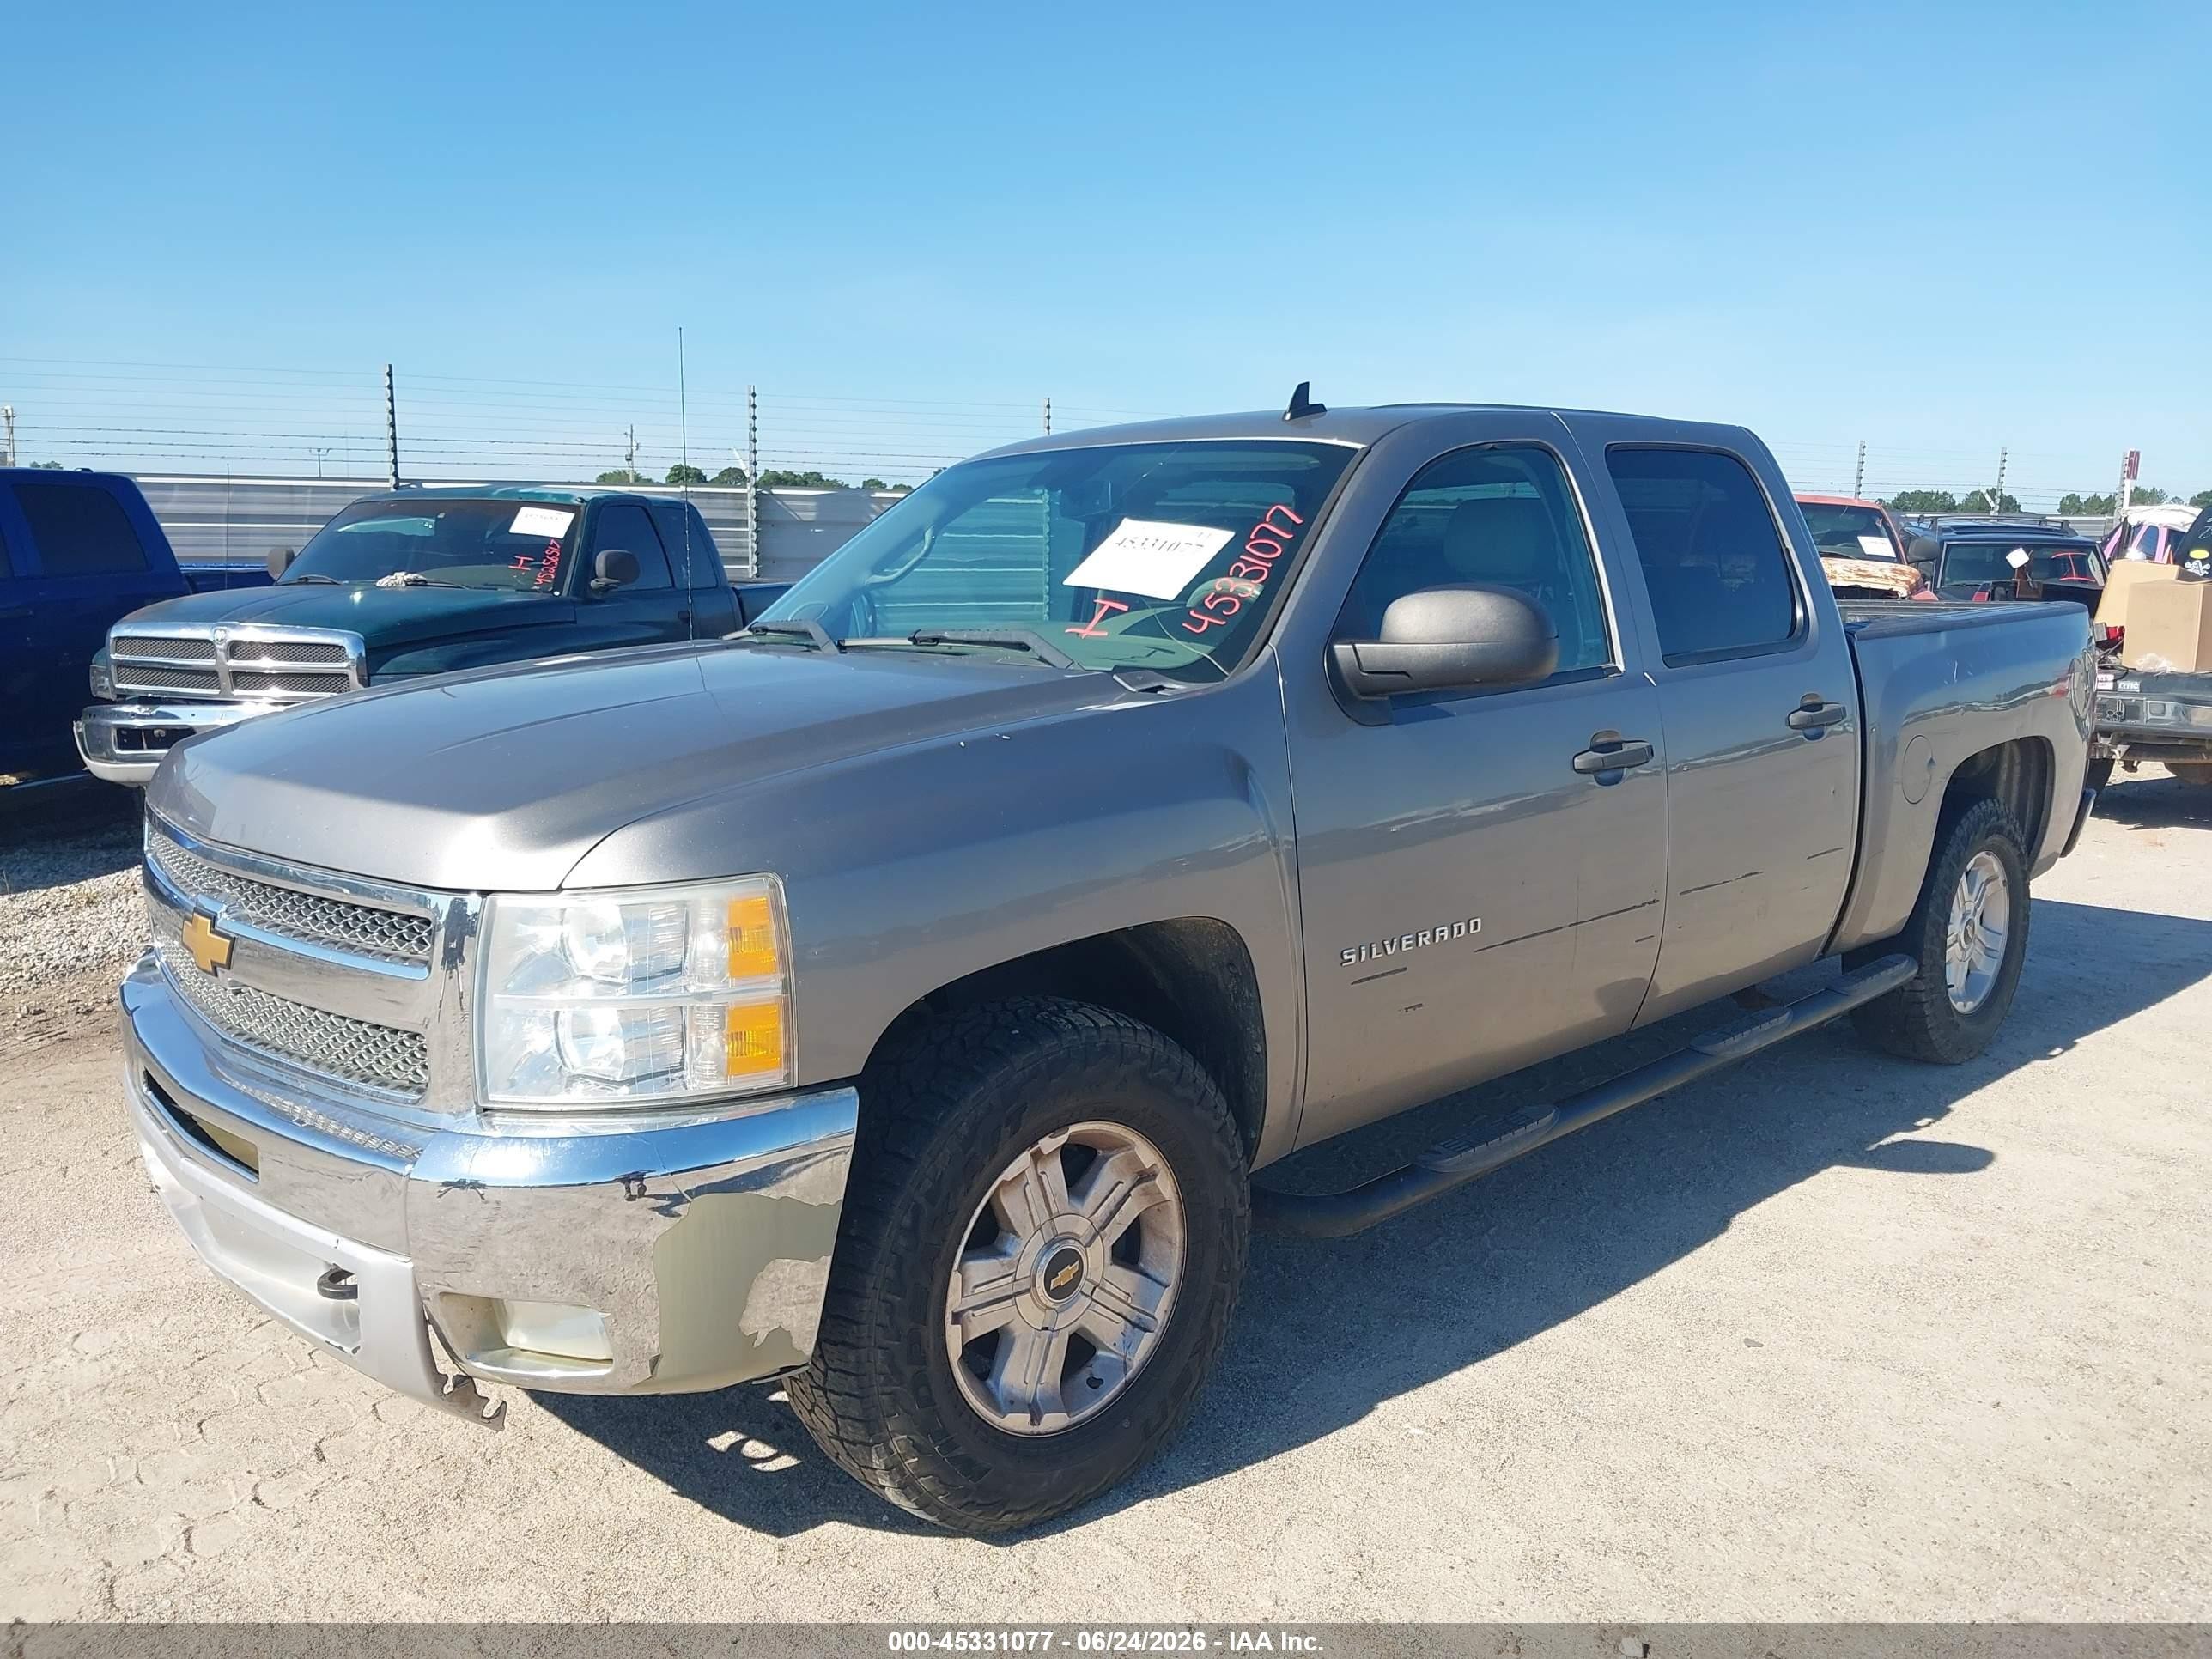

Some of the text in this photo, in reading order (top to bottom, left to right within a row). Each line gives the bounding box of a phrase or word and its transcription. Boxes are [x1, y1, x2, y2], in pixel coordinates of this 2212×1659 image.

[2127, 450, 2140, 480] 50
[1182, 504, 1304, 635] 45331077
[1340, 917, 1482, 967] SILVERADO
